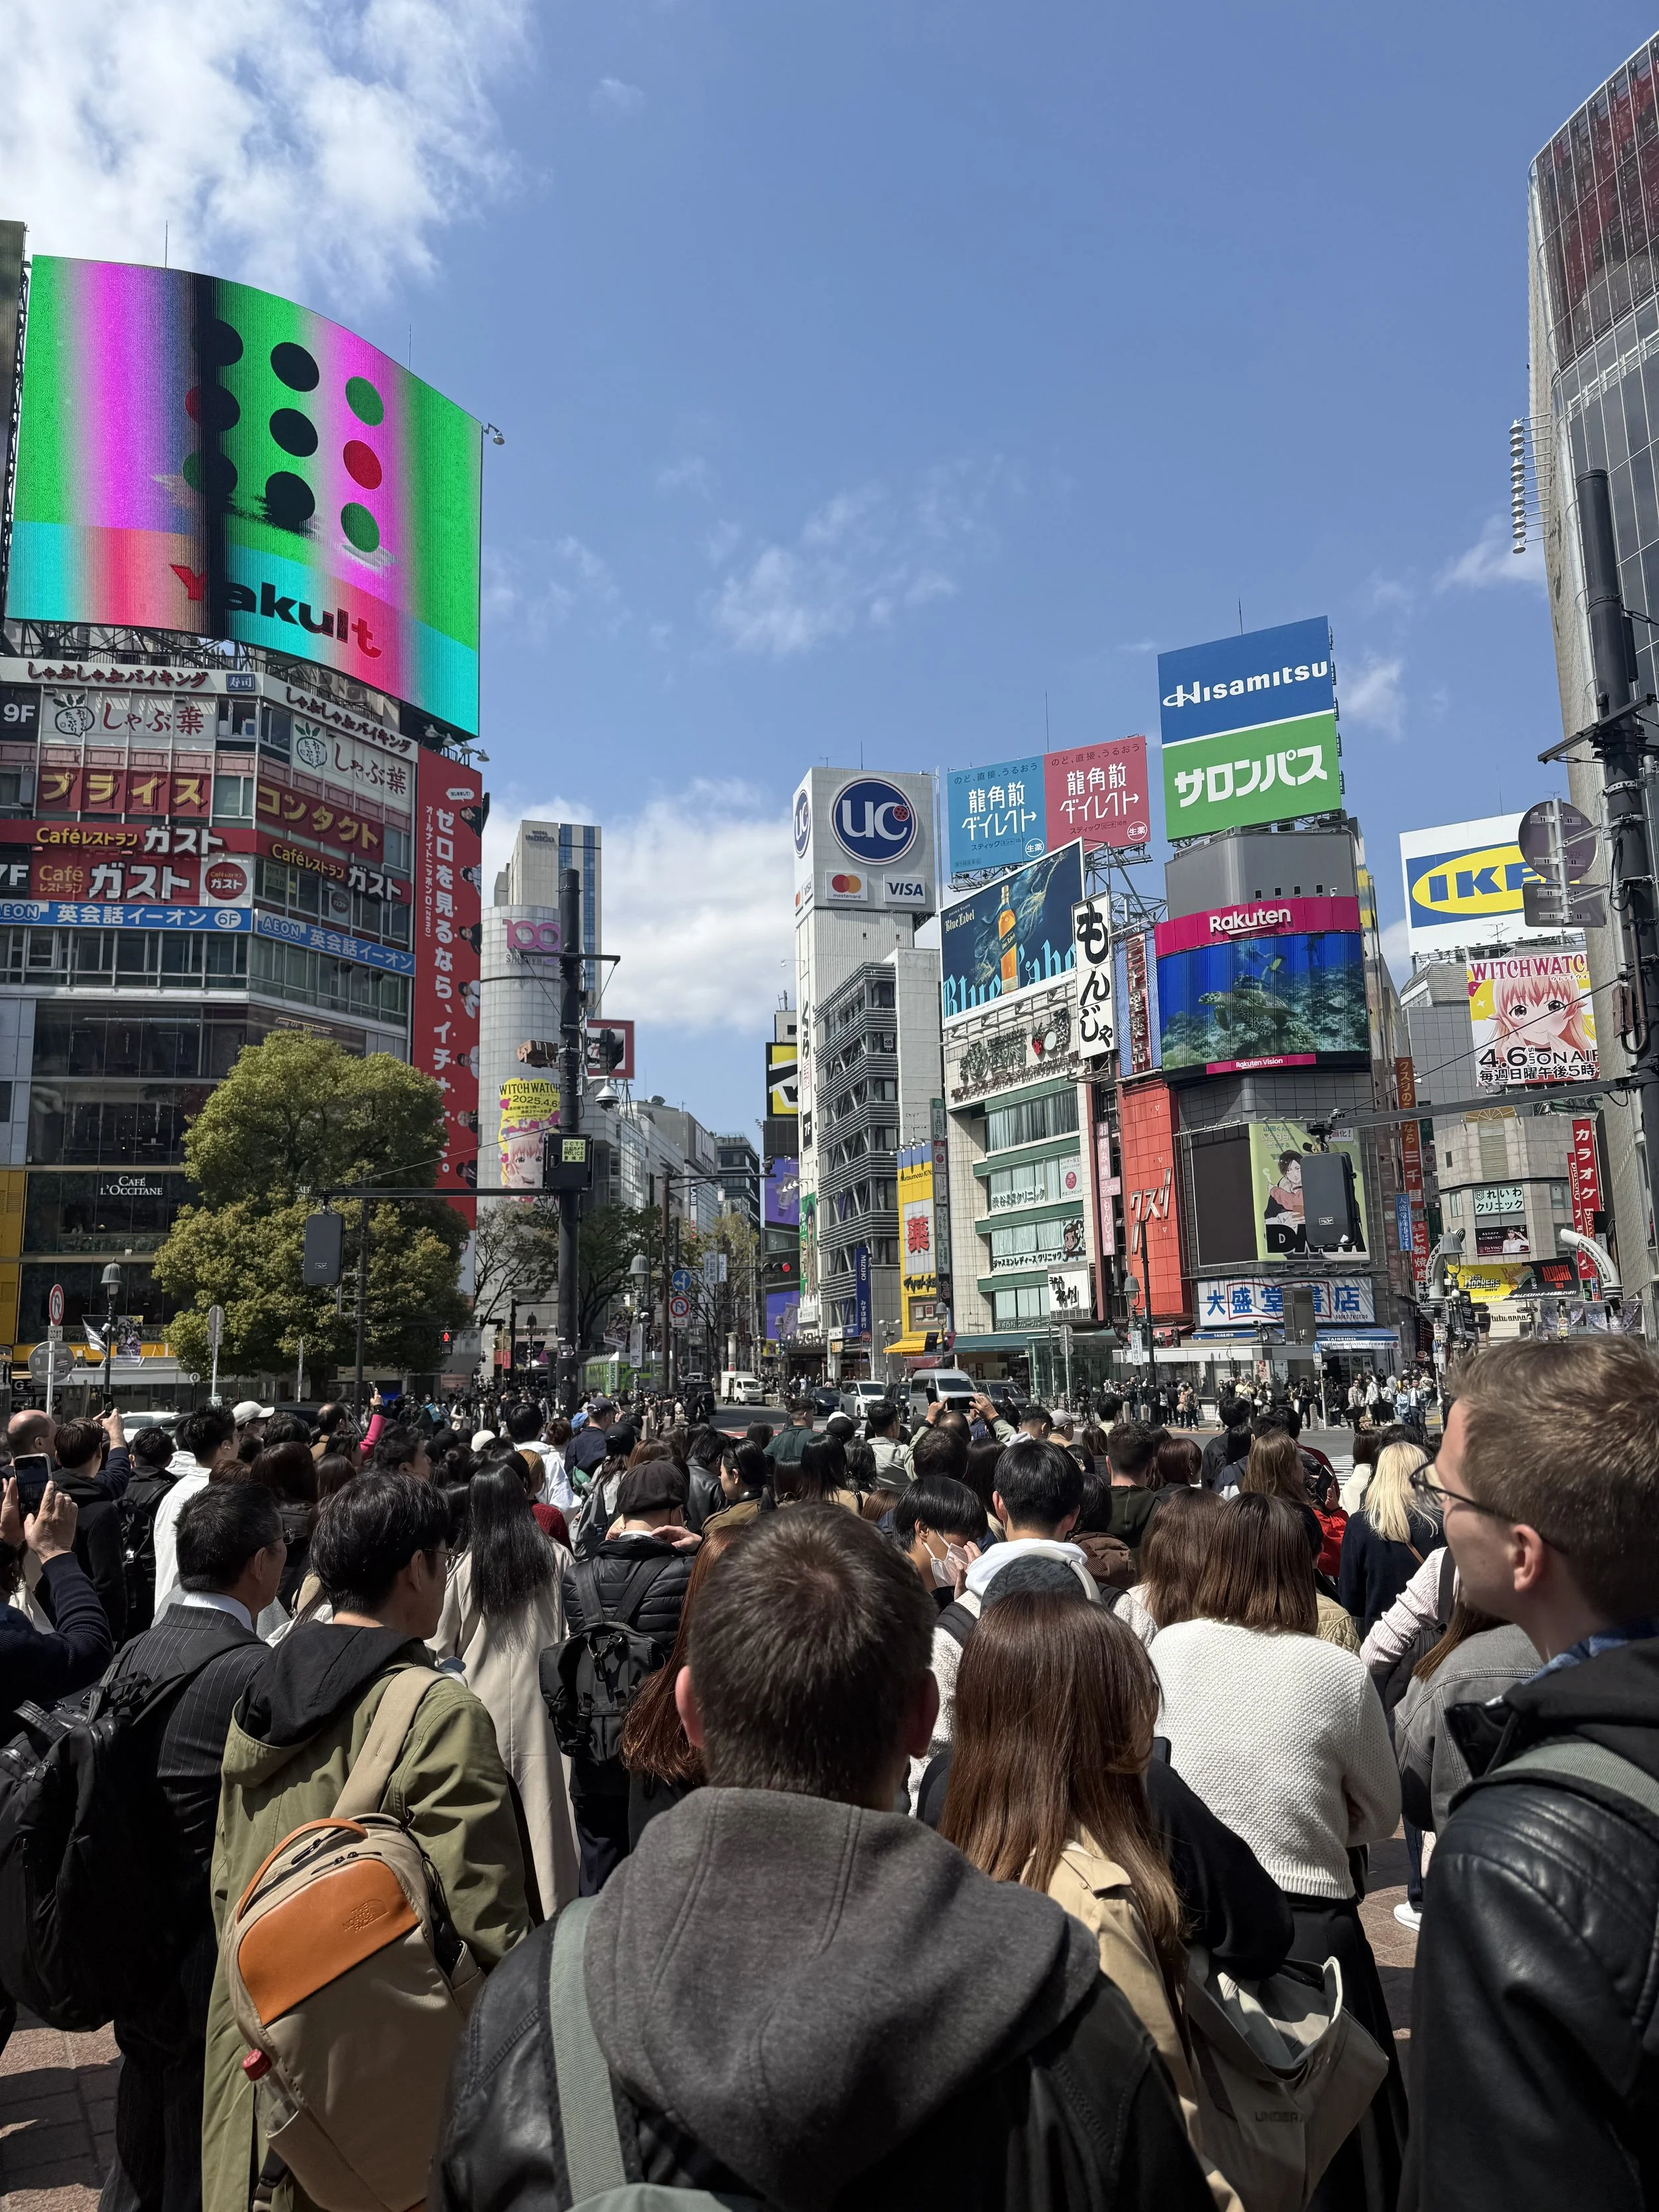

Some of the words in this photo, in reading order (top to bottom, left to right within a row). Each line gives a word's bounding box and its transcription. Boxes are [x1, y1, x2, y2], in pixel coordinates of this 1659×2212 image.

[169, 564, 383, 659] Yakult
[28, 662, 209, 688] しゃぶしゃぶバイキング
[229, 676, 253, 688] 寿司
[1163, 661, 1327, 707] Hisamitsu
[3, 703, 36, 723] 9F
[103, 702, 204, 736] しゃぶ葉
[285, 686, 412, 753] しゃぶしゃぶバイキング
[1052, 743, 1140, 767] のど、直接、うるおう
[335, 743, 406, 795] しゃぶ葉
[954, 763, 1037, 784] のど、直接、うるおう
[1067, 763, 1127, 796] 龍角散
[1174, 745, 1328, 808] サロンパス
[42, 772, 207, 808] プライス
[968, 781, 1025, 814] 龍角散
[257, 784, 380, 849] コンタクト
[842, 799, 908, 841] UC
[1060, 790, 1139, 824] ダイレクト
[962, 808, 1037, 841] ダイレクト
[1070, 824, 1101, 835] スティック
[1129, 826, 1146, 836] 生薬
[143, 826, 224, 855] ガスト
[972, 841, 1001, 851] スティック
[1027, 843, 1043, 853] 生薬
[39, 865, 84, 883] Café
[88, 861, 192, 901] ガスト
[210, 878, 243, 889] ガスト
[347, 865, 402, 901] ガスト
[1428, 861, 1541, 903] IKE
[40, 883, 82, 894] レストラン
[886, 881, 924, 897] VISA
[57, 904, 207, 926] 英会話イーオン
[217, 913, 238, 926] 6F
[261, 916, 301, 940] AEON
[945, 919, 959, 934] Blue
[958, 909, 975, 928] Label
[1209, 907, 1291, 933] Rakuten
[310, 928, 413, 970] 英会話イーオン
[1076, 900, 1114, 1048] もんじゃ
[1471, 960, 1532, 981] WITCH
[433, 808, 455, 1173] ゼロを見るなら、イチナ。
[1236, 1060, 1262, 1069] Rakuten
[1262, 1057, 1283, 1067] Vision
[1479, 1046, 1527, 1069] 4.6
[1536, 1051, 1567, 1065] ON
[499, 1082, 530, 1096] WITCH
[531, 1082, 561, 1094] WATCH
[512, 1095, 557, 1108] 2025.4.6
[1404, 1150, 1423, 1203] 三千里
[1575, 1129, 1597, 1199] カラオケ
[1476, 1199, 1523, 1213] クリニック
[1486, 1187, 1522, 1200] れいわ
[1130, 1168, 1171, 1254] クスリ
[907, 1216, 930, 1254] 薬
[1039, 1252, 1062, 1263] クリニック
[1464, 1276, 1501, 1290] ROCKERS
